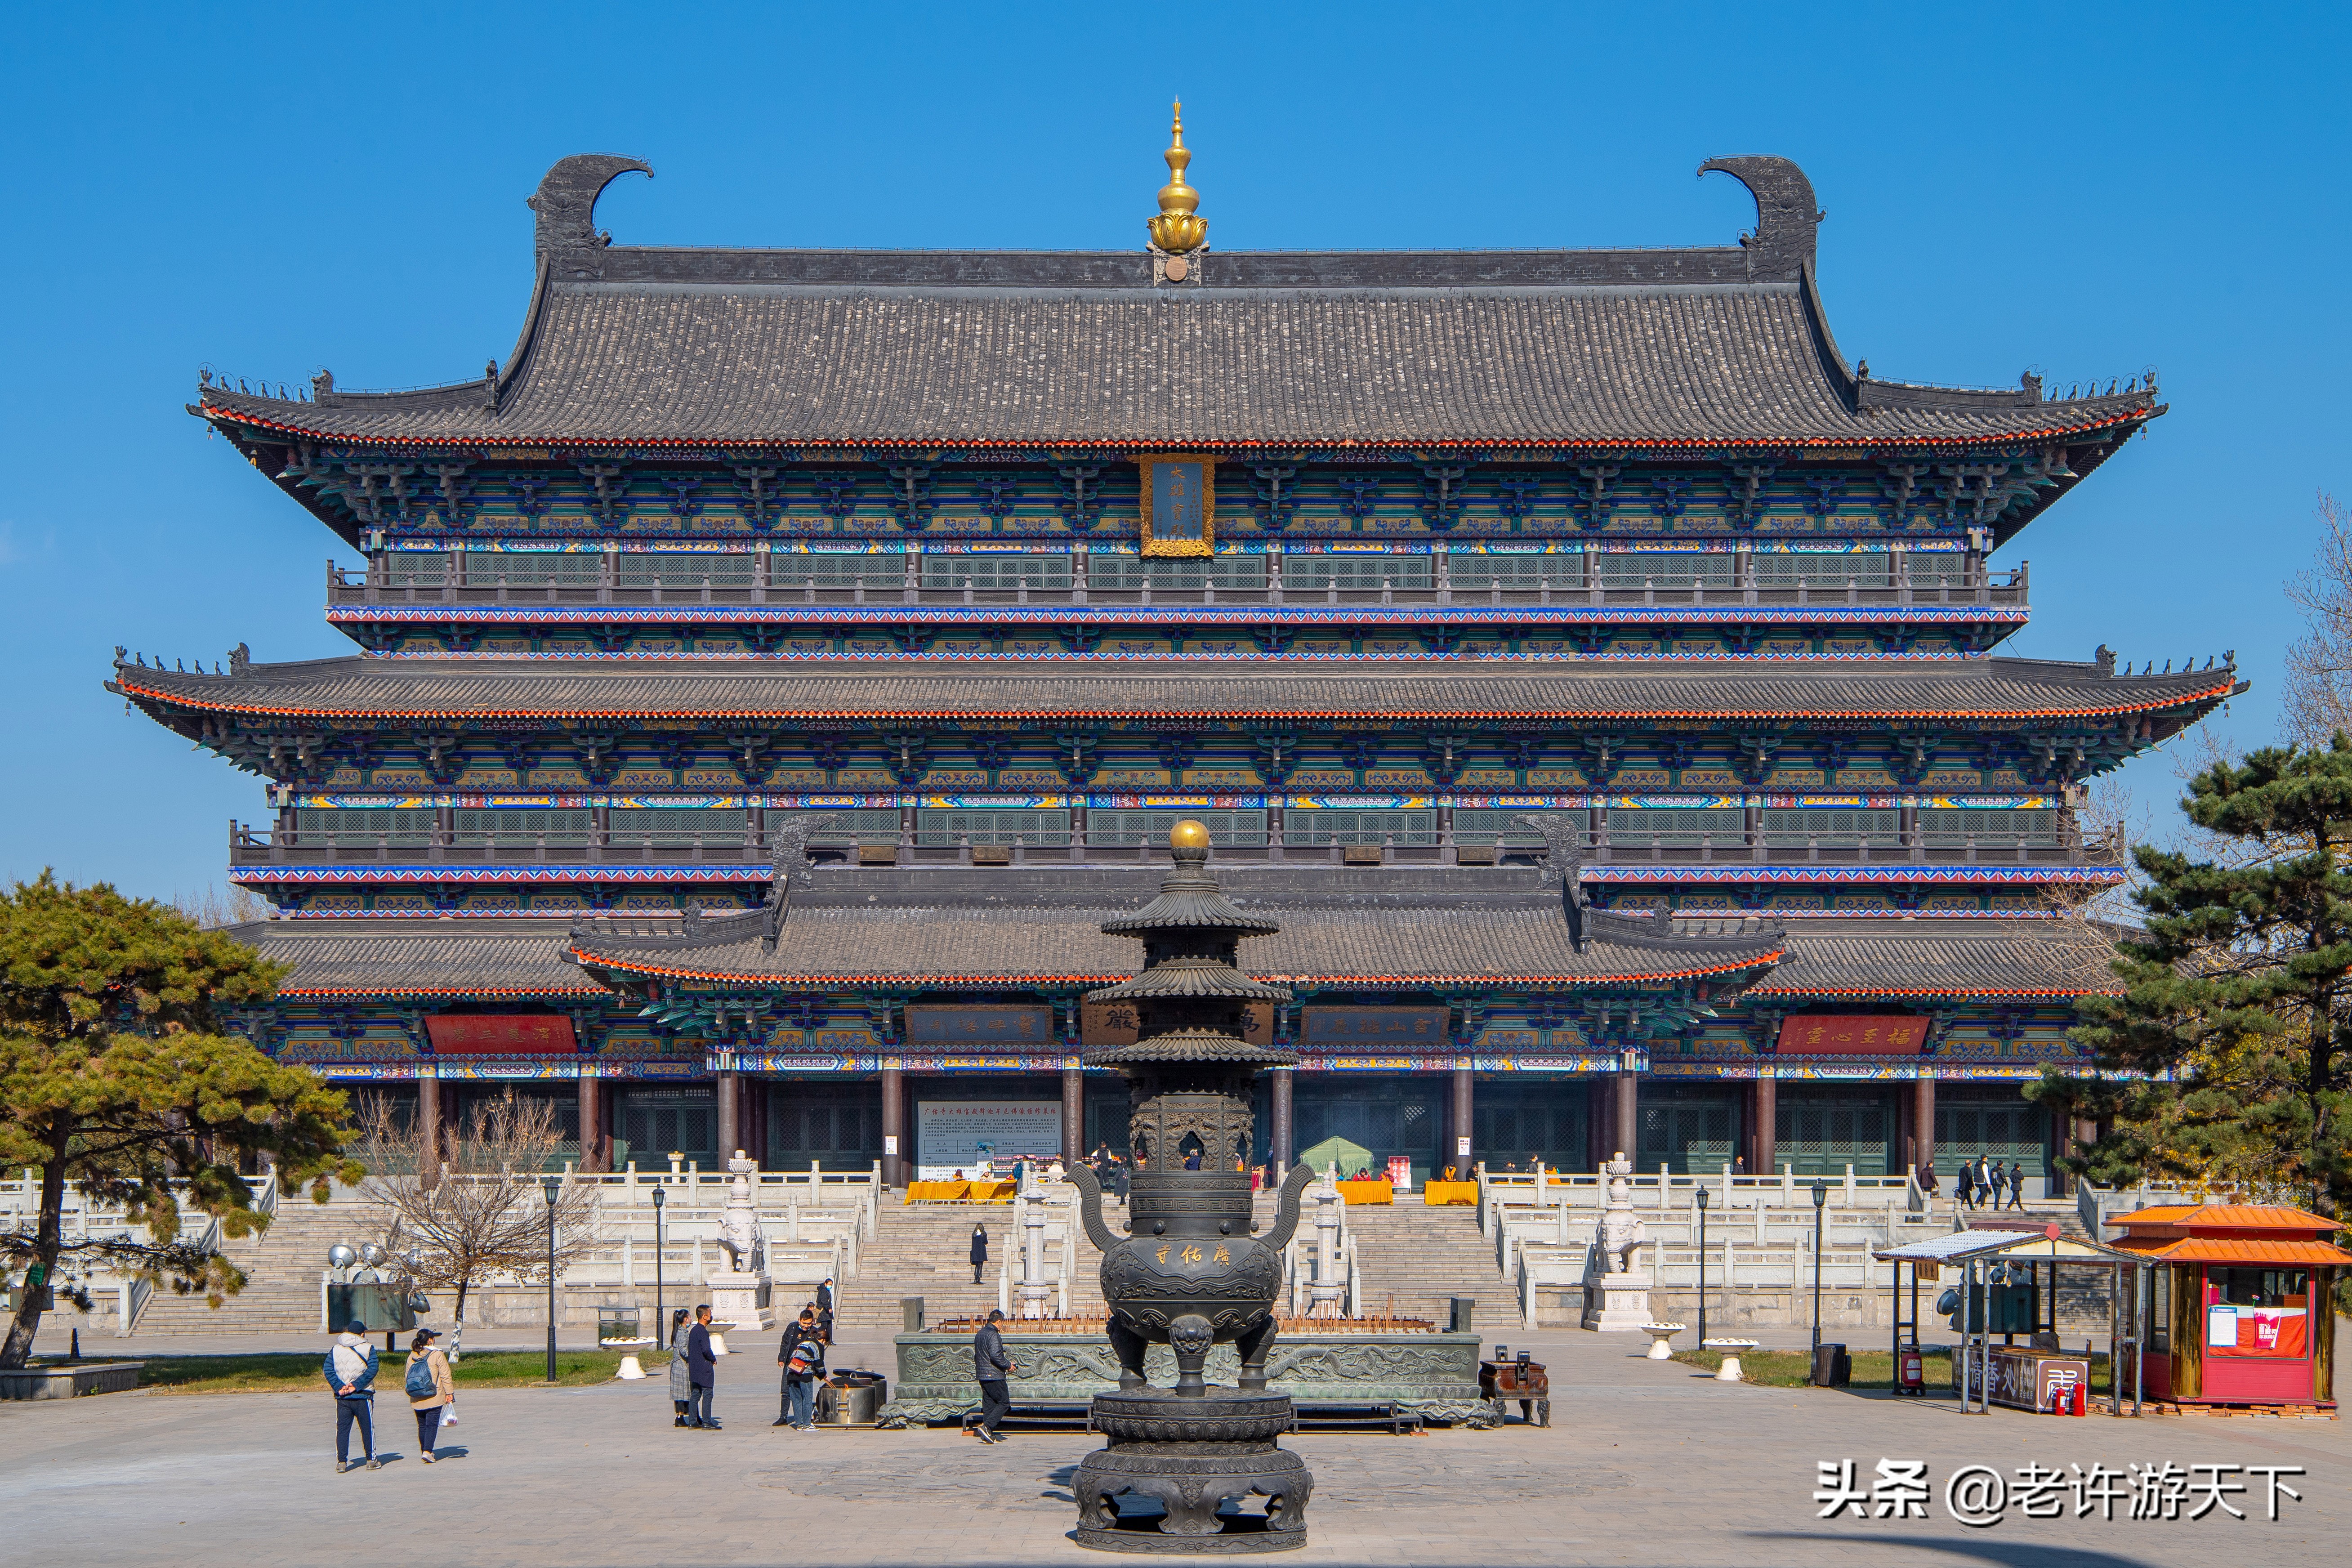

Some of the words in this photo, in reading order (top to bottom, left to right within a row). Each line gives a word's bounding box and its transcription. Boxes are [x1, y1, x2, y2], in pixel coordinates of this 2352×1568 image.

[1166, 465, 1187, 537] 大雄寶殿
[1155, 1242, 1231, 1266] 廣佑寺
[1969, 1358, 2016, 1397] 请香处
